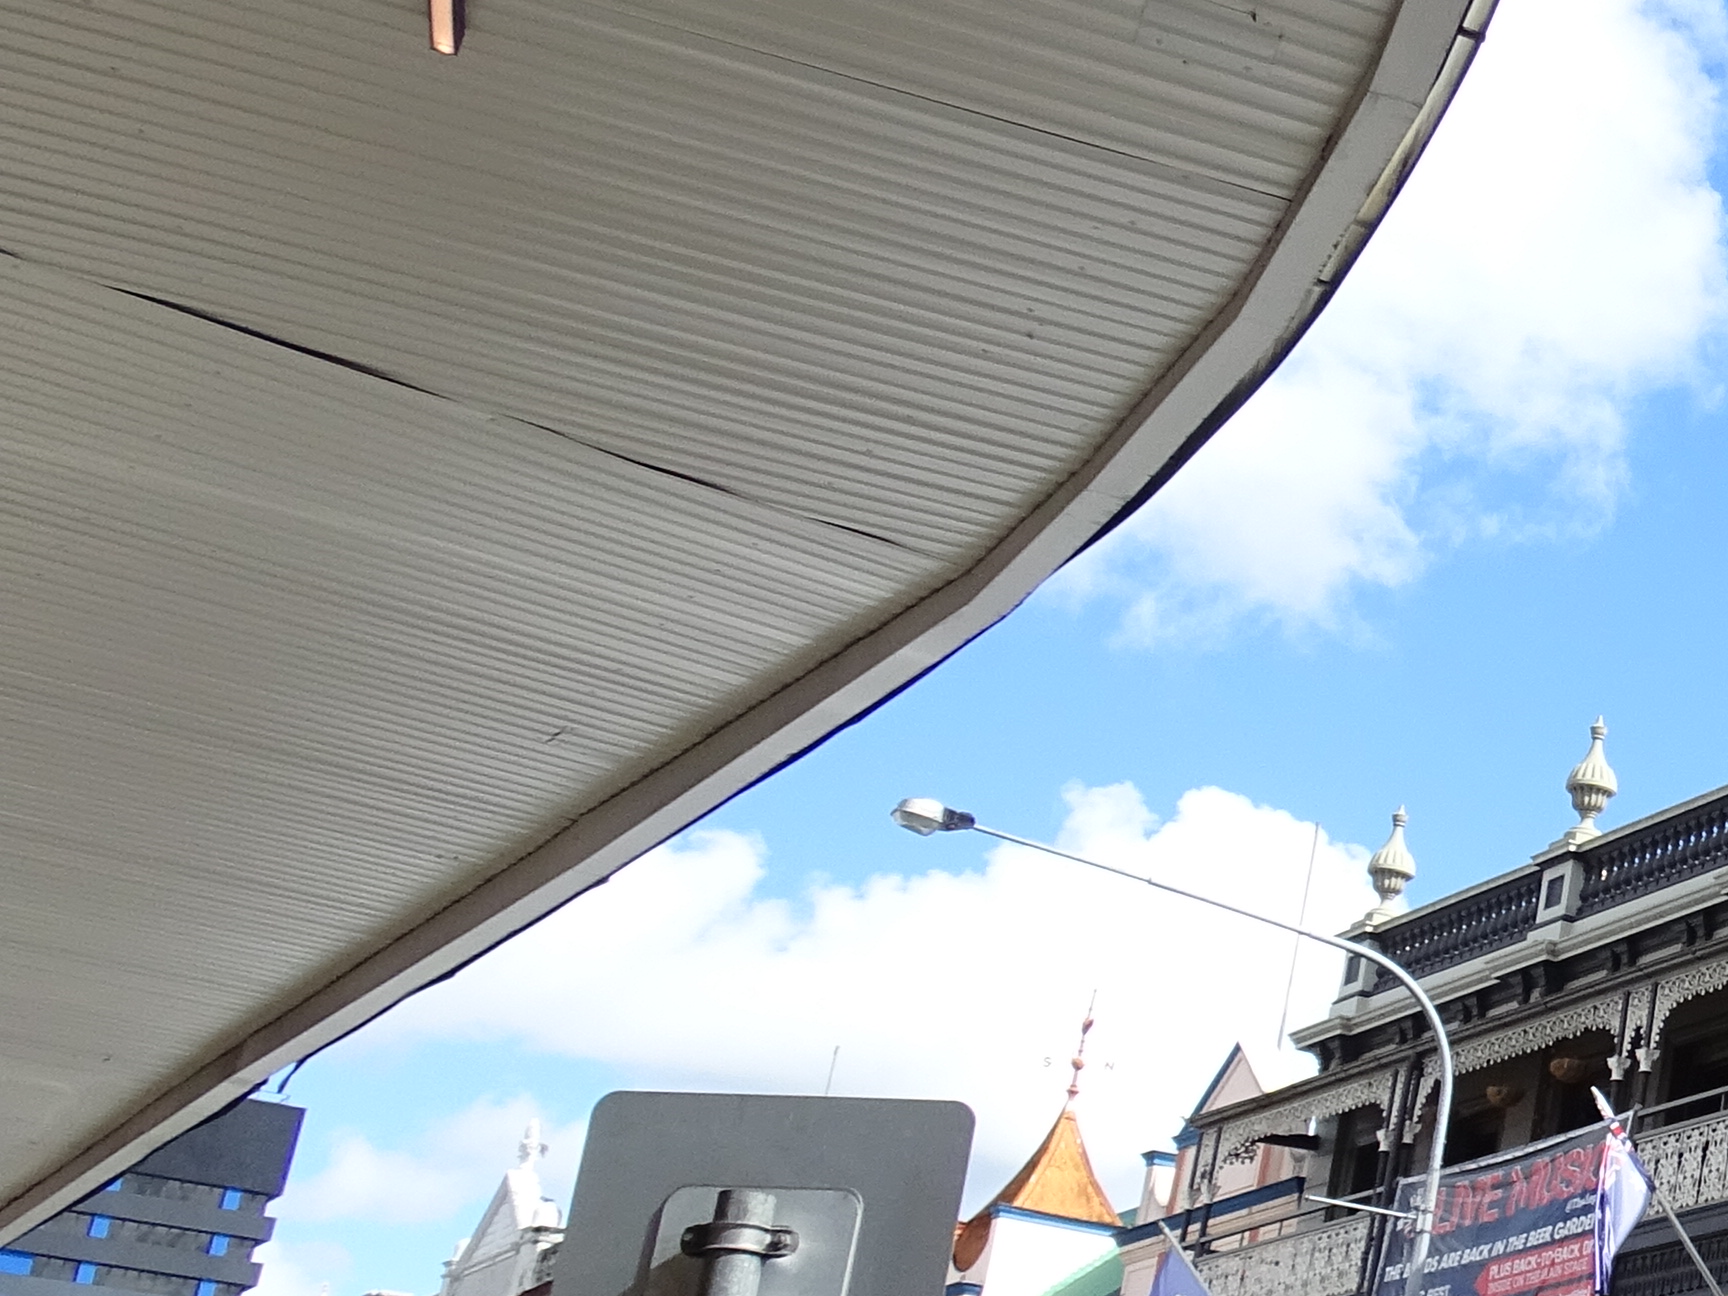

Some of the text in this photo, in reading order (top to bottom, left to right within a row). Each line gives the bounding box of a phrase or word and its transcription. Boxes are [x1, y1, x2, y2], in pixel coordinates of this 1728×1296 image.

[1431, 1172, 1503, 1235] LIVE
[1384, 1264, 1404, 1282] THE
[1438, 1251, 1462, 1270] ARE
[1460, 1243, 1493, 1264] BACK
[1490, 1239, 1506, 1257] IN
[1506, 1233, 1528, 1253] THE
[1526, 1225, 1553, 1247] BEER
[1489, 1261, 1512, 1280] PLUS
[1512, 1243, 1581, 1275] BACK-TO-BACK
